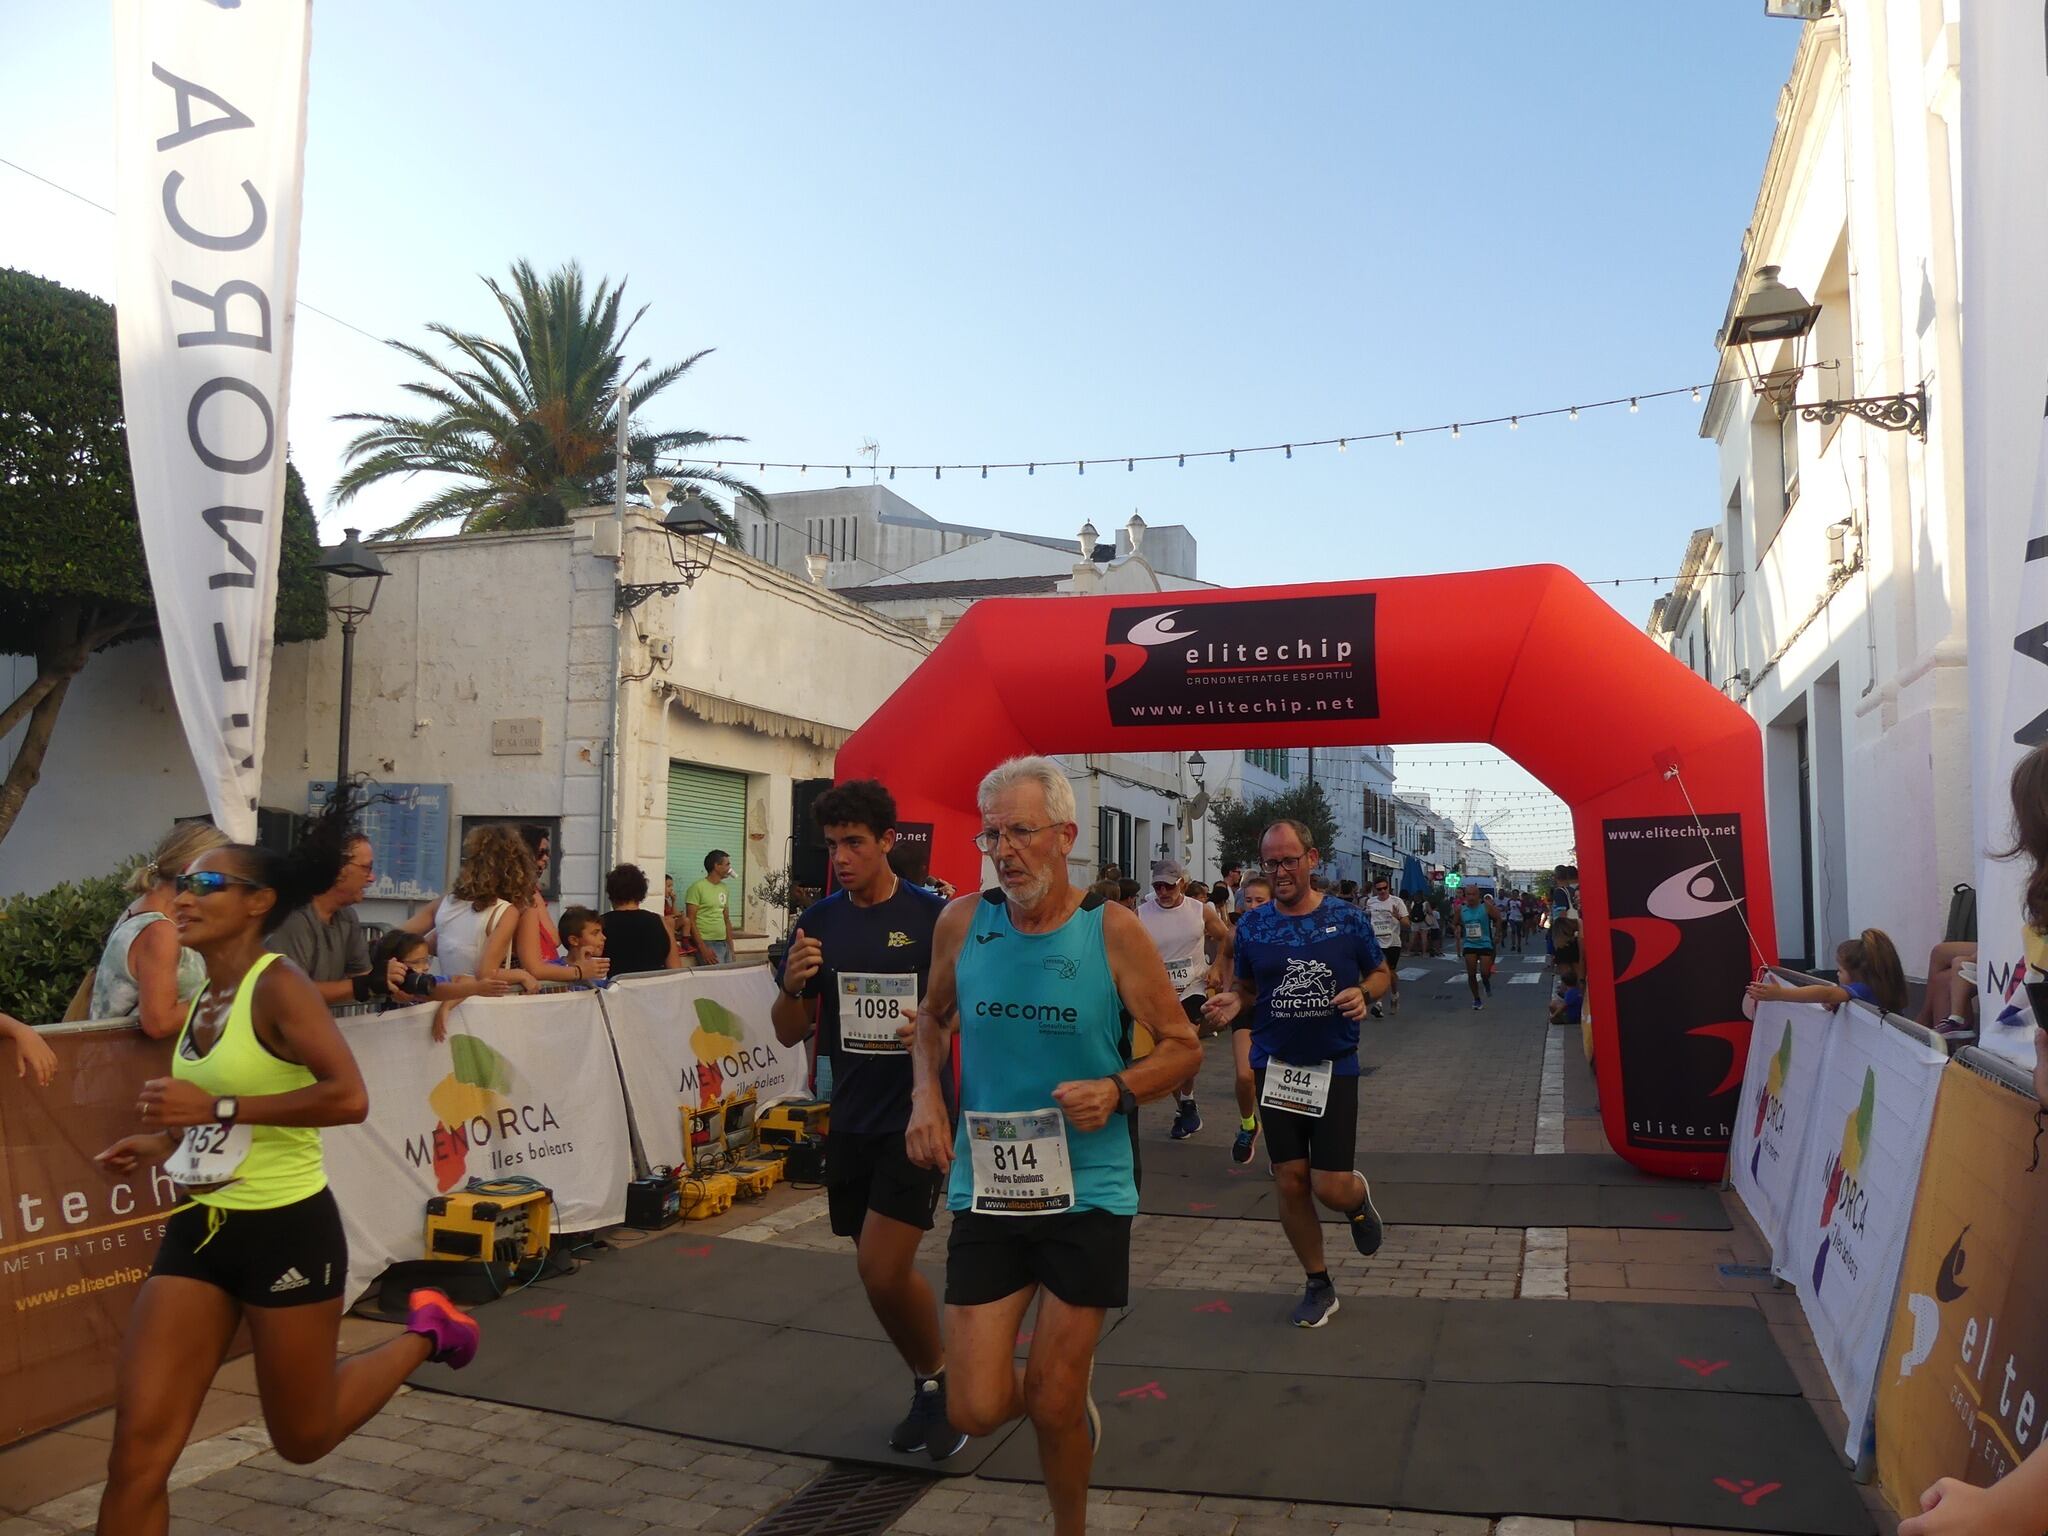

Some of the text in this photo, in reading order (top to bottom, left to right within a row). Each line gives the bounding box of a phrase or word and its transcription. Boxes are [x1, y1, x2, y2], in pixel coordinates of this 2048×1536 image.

[1186, 638, 1353, 664] elitechip
[1186, 671, 1353, 686] CRONOMETRATGE ESPORTIU
[1131, 697, 1355, 716] www.elitechip.net
[1608, 825, 1737, 840] www.elitechip.net
[1167, 968, 1188, 980] 1143
[854, 997, 900, 1019] 1098
[975, 1001, 1078, 1023] cecome
[679, 1044, 779, 1093] MENORCA
[1283, 1068, 1312, 1088] 844
[405, 1102, 561, 1169] MENORCA
[528, 1139, 574, 1161] balears
[993, 1143, 1038, 1171] 814
[993, 1173, 1012, 1184] Pedro
